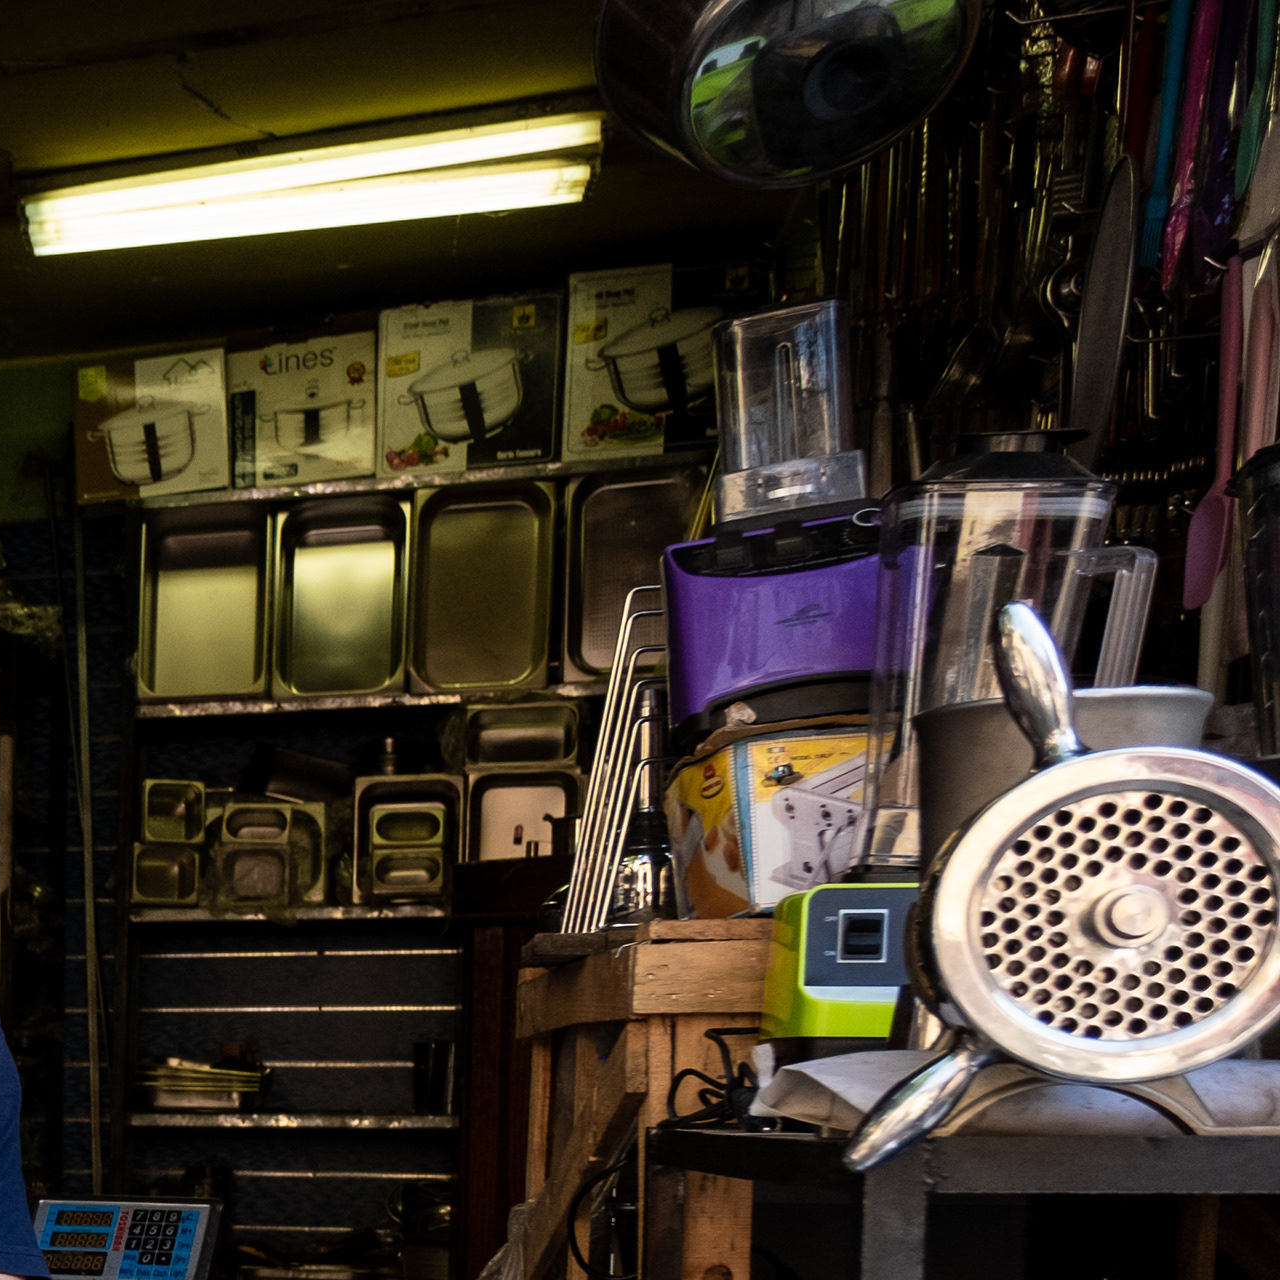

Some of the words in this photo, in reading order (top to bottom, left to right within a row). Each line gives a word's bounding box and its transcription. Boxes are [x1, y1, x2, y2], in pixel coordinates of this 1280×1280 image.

[135, 1211, 145, 1221] 7
[152, 1212, 161, 1221] 8
[169, 1212, 178, 1222] 9
[132, 1225, 141, 1235] 4
[149, 1225, 158, 1235] 5
[165, 1226, 175, 1235] 6
[130, 1240, 137, 1249] 1
[145, 1240, 155, 1250] 2
[162, 1240, 171, 1250] 3
[142, 1253, 151, 1263] 0
